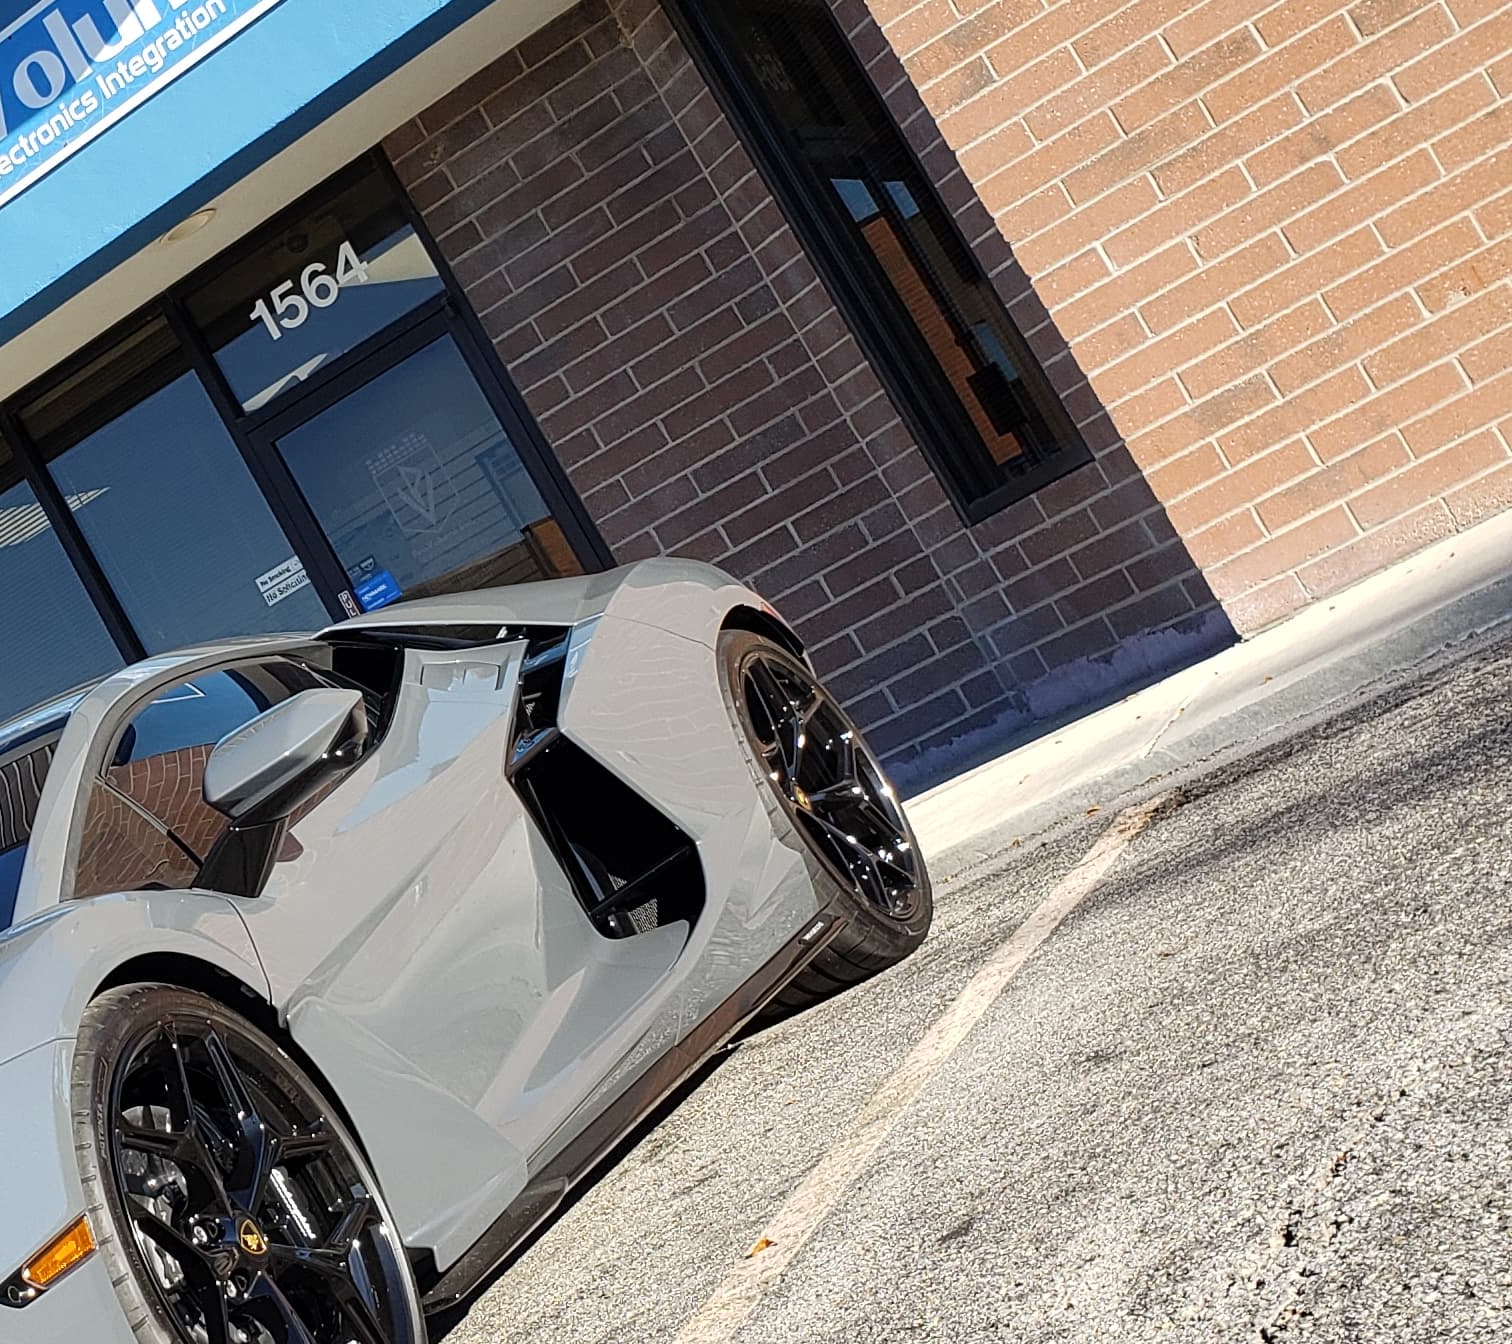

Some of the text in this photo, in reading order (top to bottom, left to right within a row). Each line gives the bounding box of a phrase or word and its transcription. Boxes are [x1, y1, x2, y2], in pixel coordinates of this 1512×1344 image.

[249, 240, 369, 340] 1564
[276, 573, 307, 596] Solicitin
[341, 593, 357, 617] PUL
